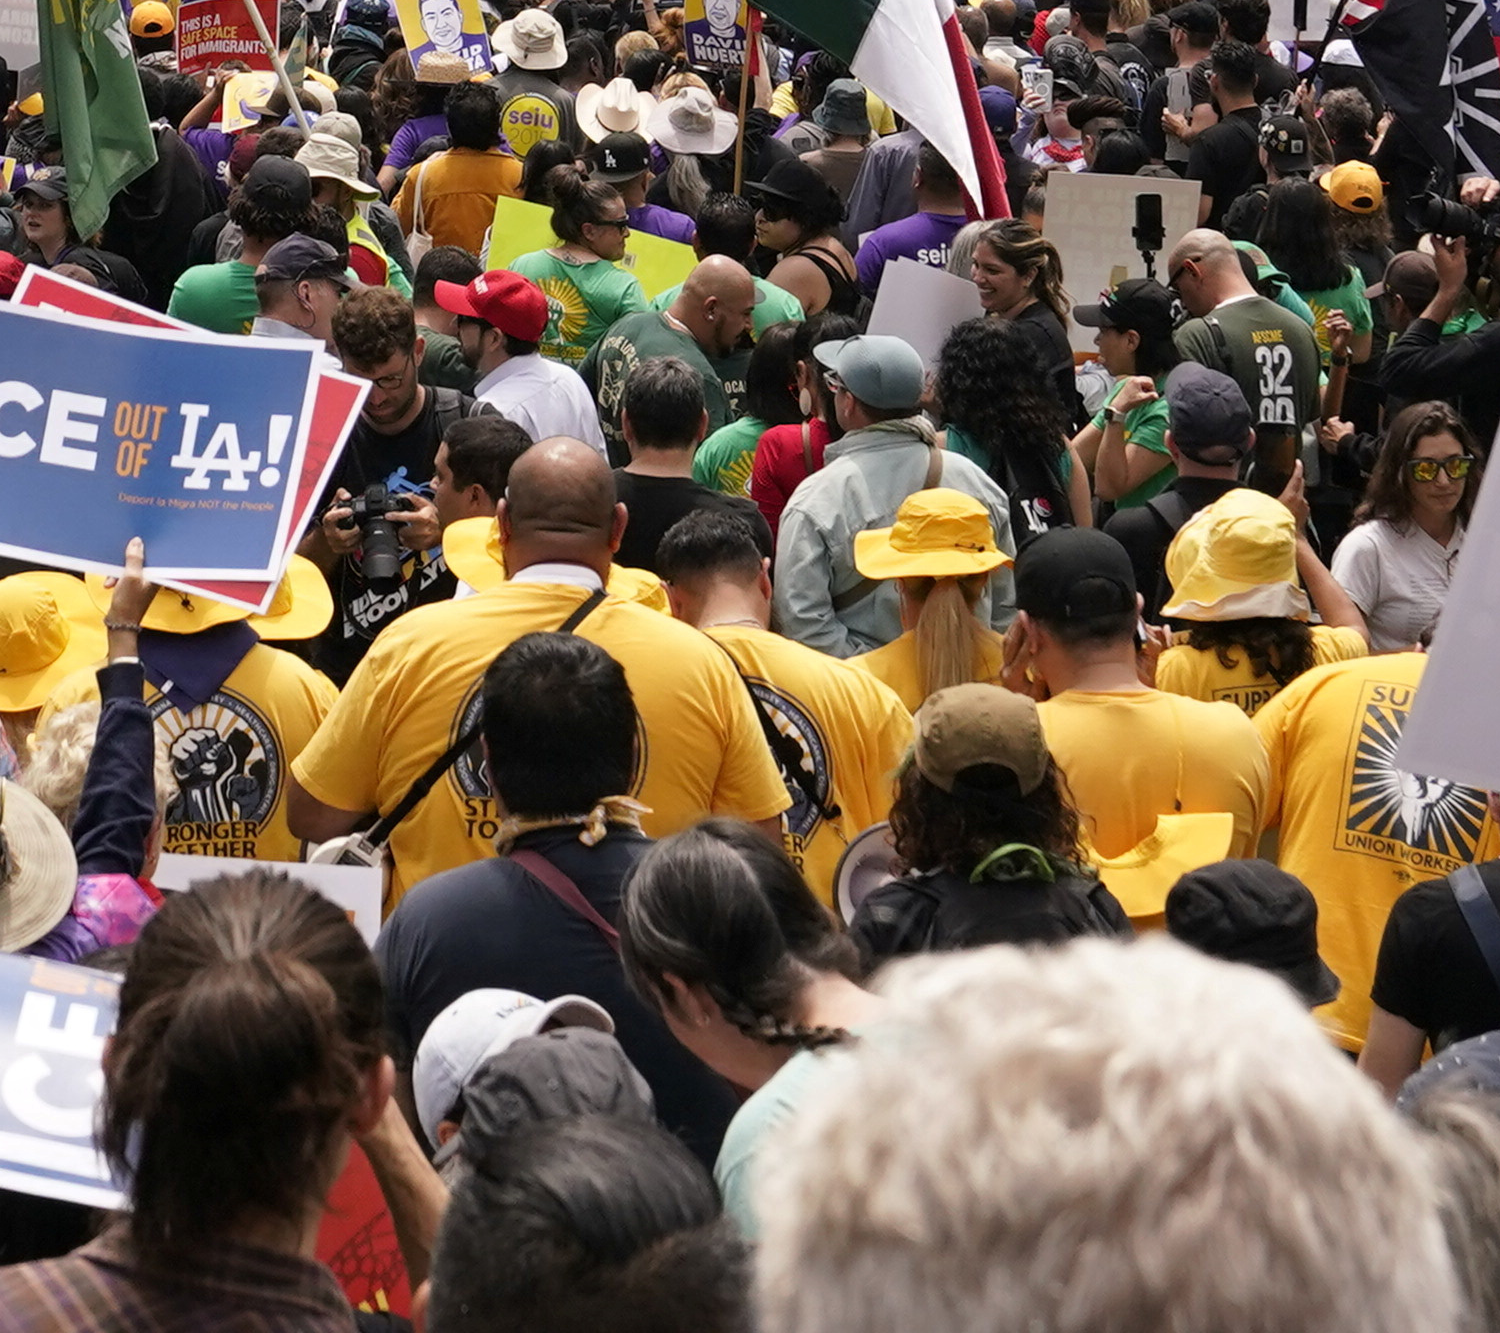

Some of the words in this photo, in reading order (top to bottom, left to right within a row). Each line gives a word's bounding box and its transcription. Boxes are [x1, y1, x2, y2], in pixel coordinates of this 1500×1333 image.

[181, 17, 200, 33] THIS
[202, 15, 213, 27] IS
[214, 14, 221, 25] A
[181, 29, 203, 47] SAFE
[203, 26, 238, 41] SPACE
[181, 45, 197, 61] FOR
[508, 108, 553, 128] seiu
[605, 149, 617, 167] LA
[917, 243, 951, 265] sei
[1255, 344, 1293, 396] 32
[113, 400, 168, 441] OUT
[170, 402, 293, 492] LA!
[115, 440, 153, 479] OF
[117, 492, 153, 506] Deport
[156, 498, 167, 507] la
[169, 499, 195, 510] Migra
[198, 500, 219, 510] NOT
[223, 501, 238, 510] the
[240, 501, 274, 511] People
[235, 704, 274, 751] HEALTHCARE
